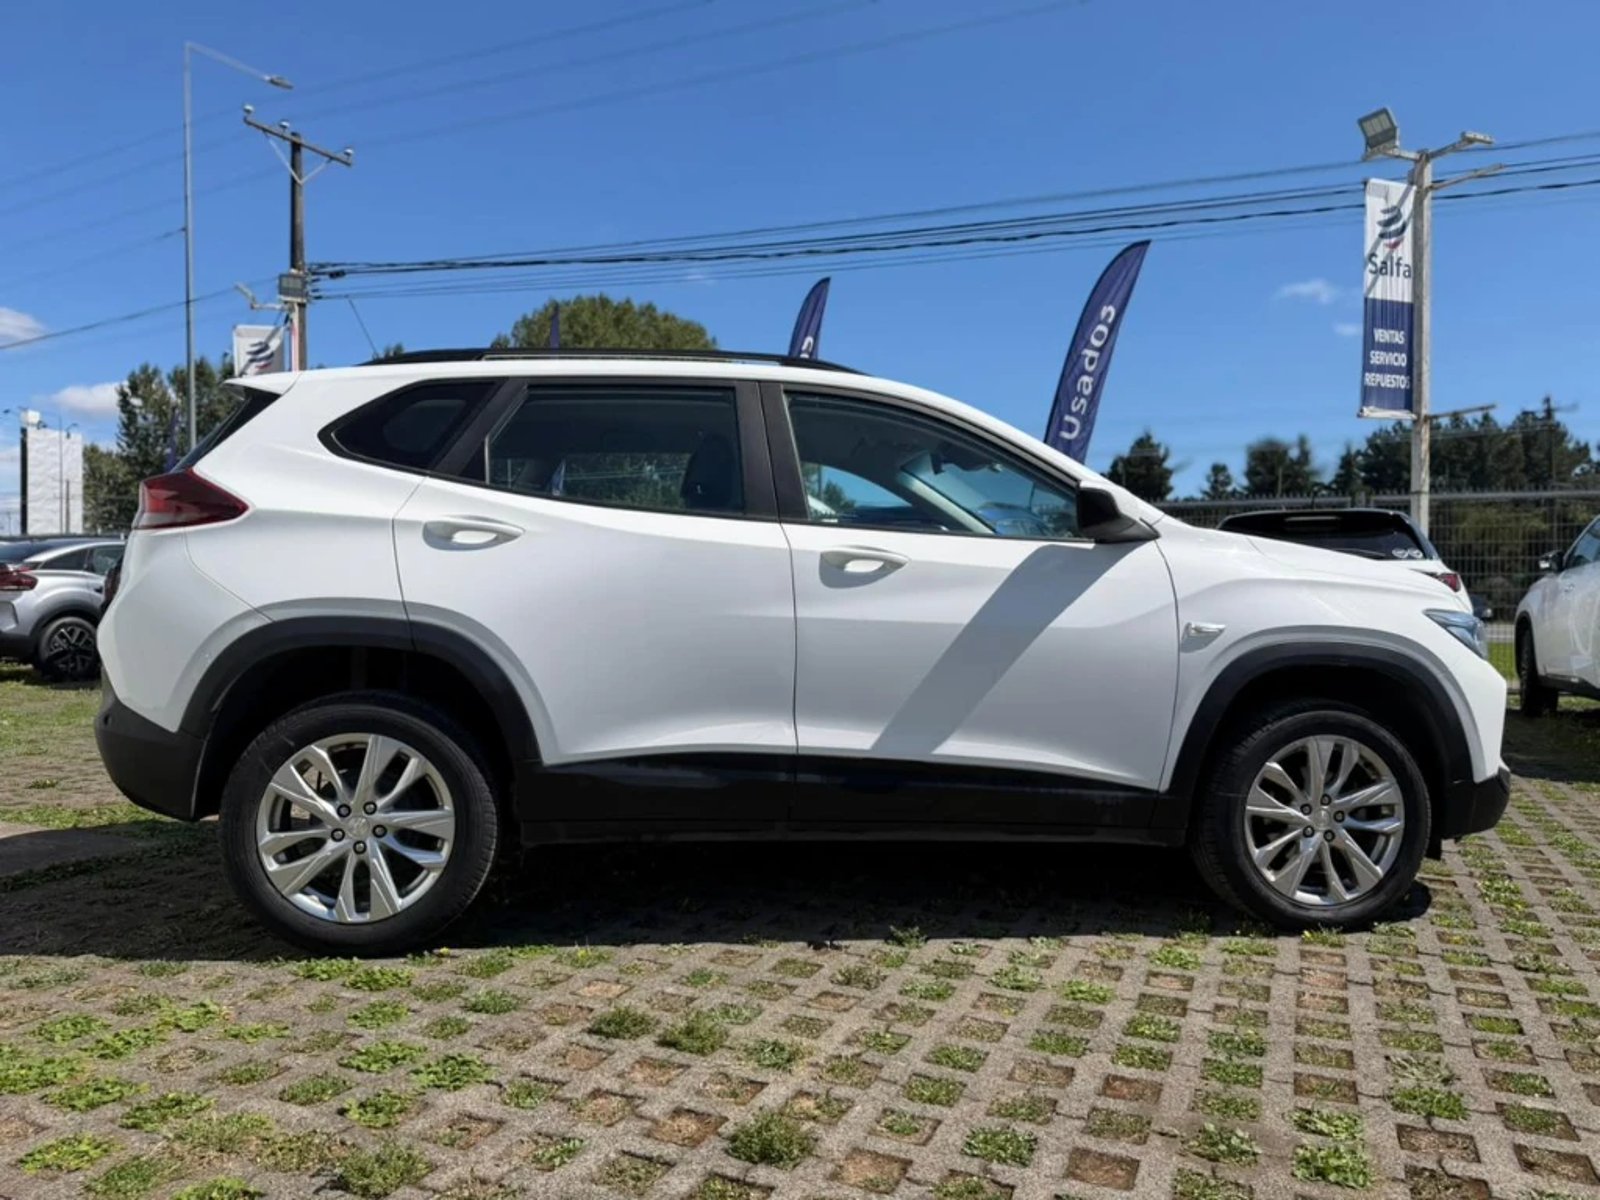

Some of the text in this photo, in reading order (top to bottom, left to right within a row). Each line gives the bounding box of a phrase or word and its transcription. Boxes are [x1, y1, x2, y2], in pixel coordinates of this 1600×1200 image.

[1368, 252, 1411, 279] Salfa
[1373, 328, 1405, 344] VENTAS
[1369, 350, 1407, 367] SERVICIO
[1060, 304, 1116, 440] Usados
[1364, 372, 1411, 389] REPUESTOS
